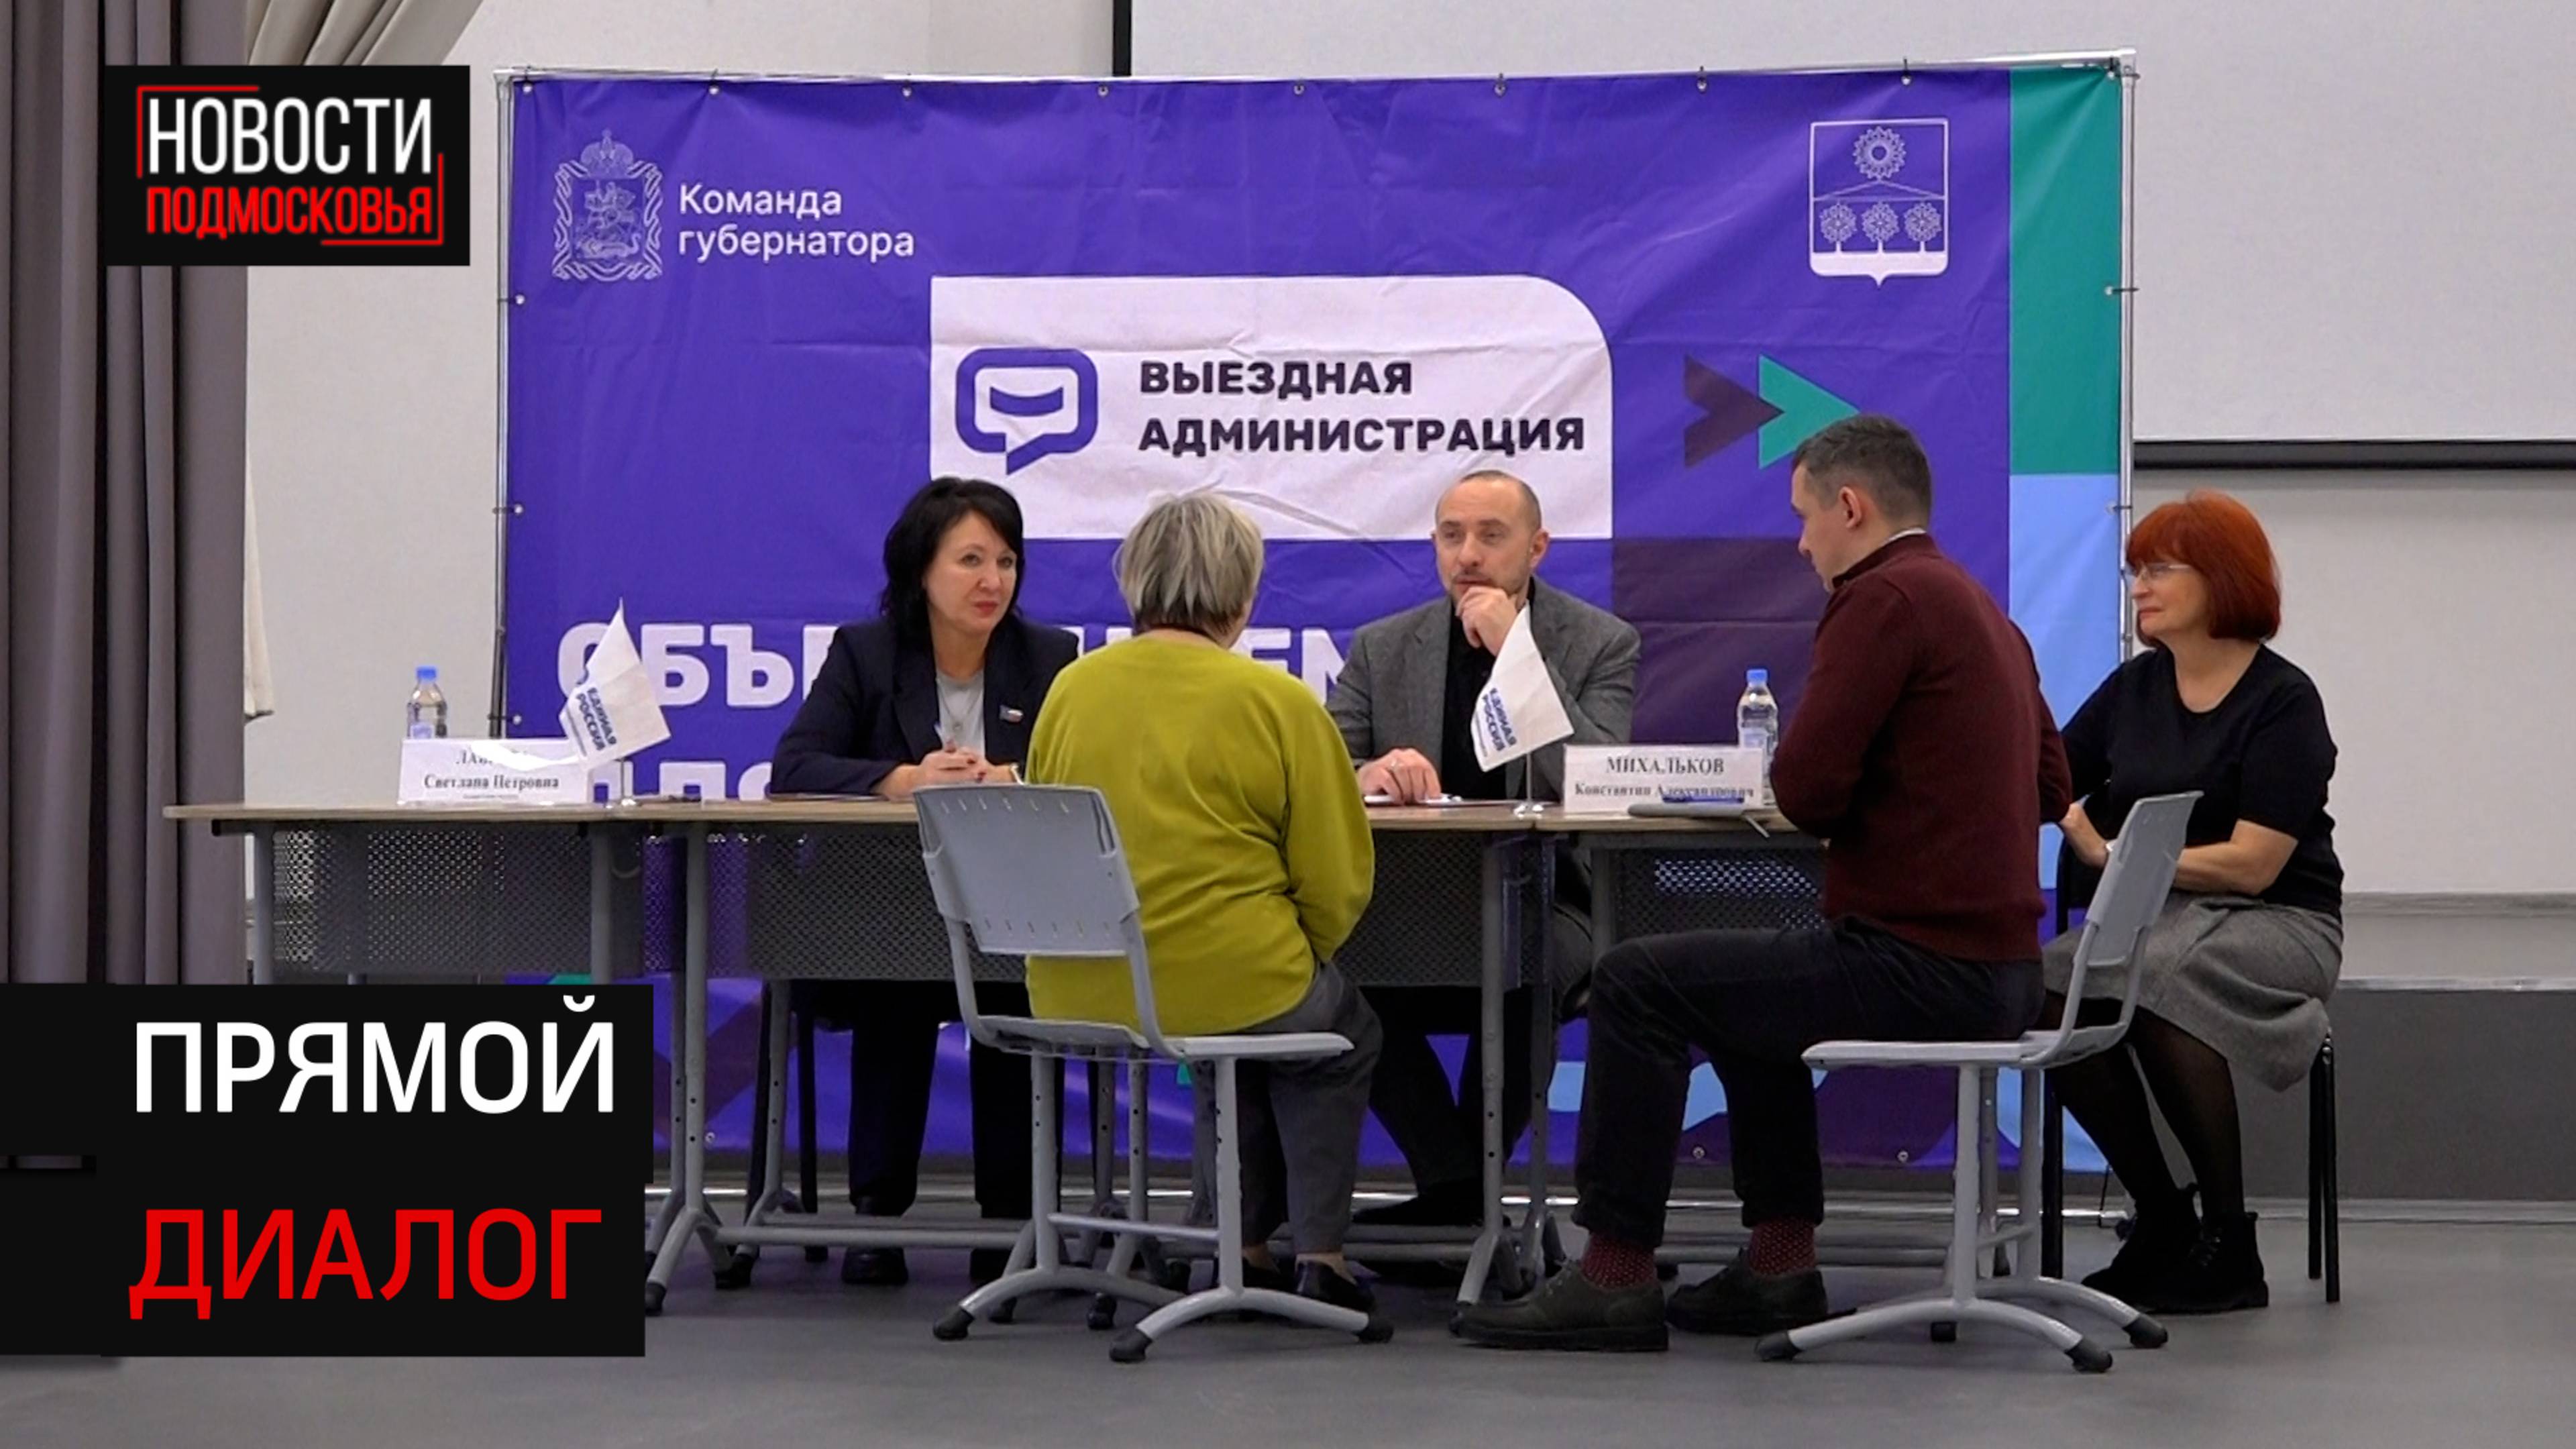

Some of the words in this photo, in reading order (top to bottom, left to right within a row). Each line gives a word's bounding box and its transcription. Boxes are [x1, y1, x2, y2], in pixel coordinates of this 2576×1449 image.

[679, 184, 843, 221] Команда
[678, 224, 914, 262] губернатора
[1140, 361, 1412, 400] ВЫЕЗДНАЯ
[1138, 417, 1585, 457] АДМИНИСТРАЦИЯ
[576, 693, 606, 751] РОССИЯ
[423, 774, 490, 789] Светлана
[493, 774, 559, 792] Петровна
[1606, 755, 1725, 775] МИХАЛЬКОВ
[1574, 782, 1651, 797] Константин
